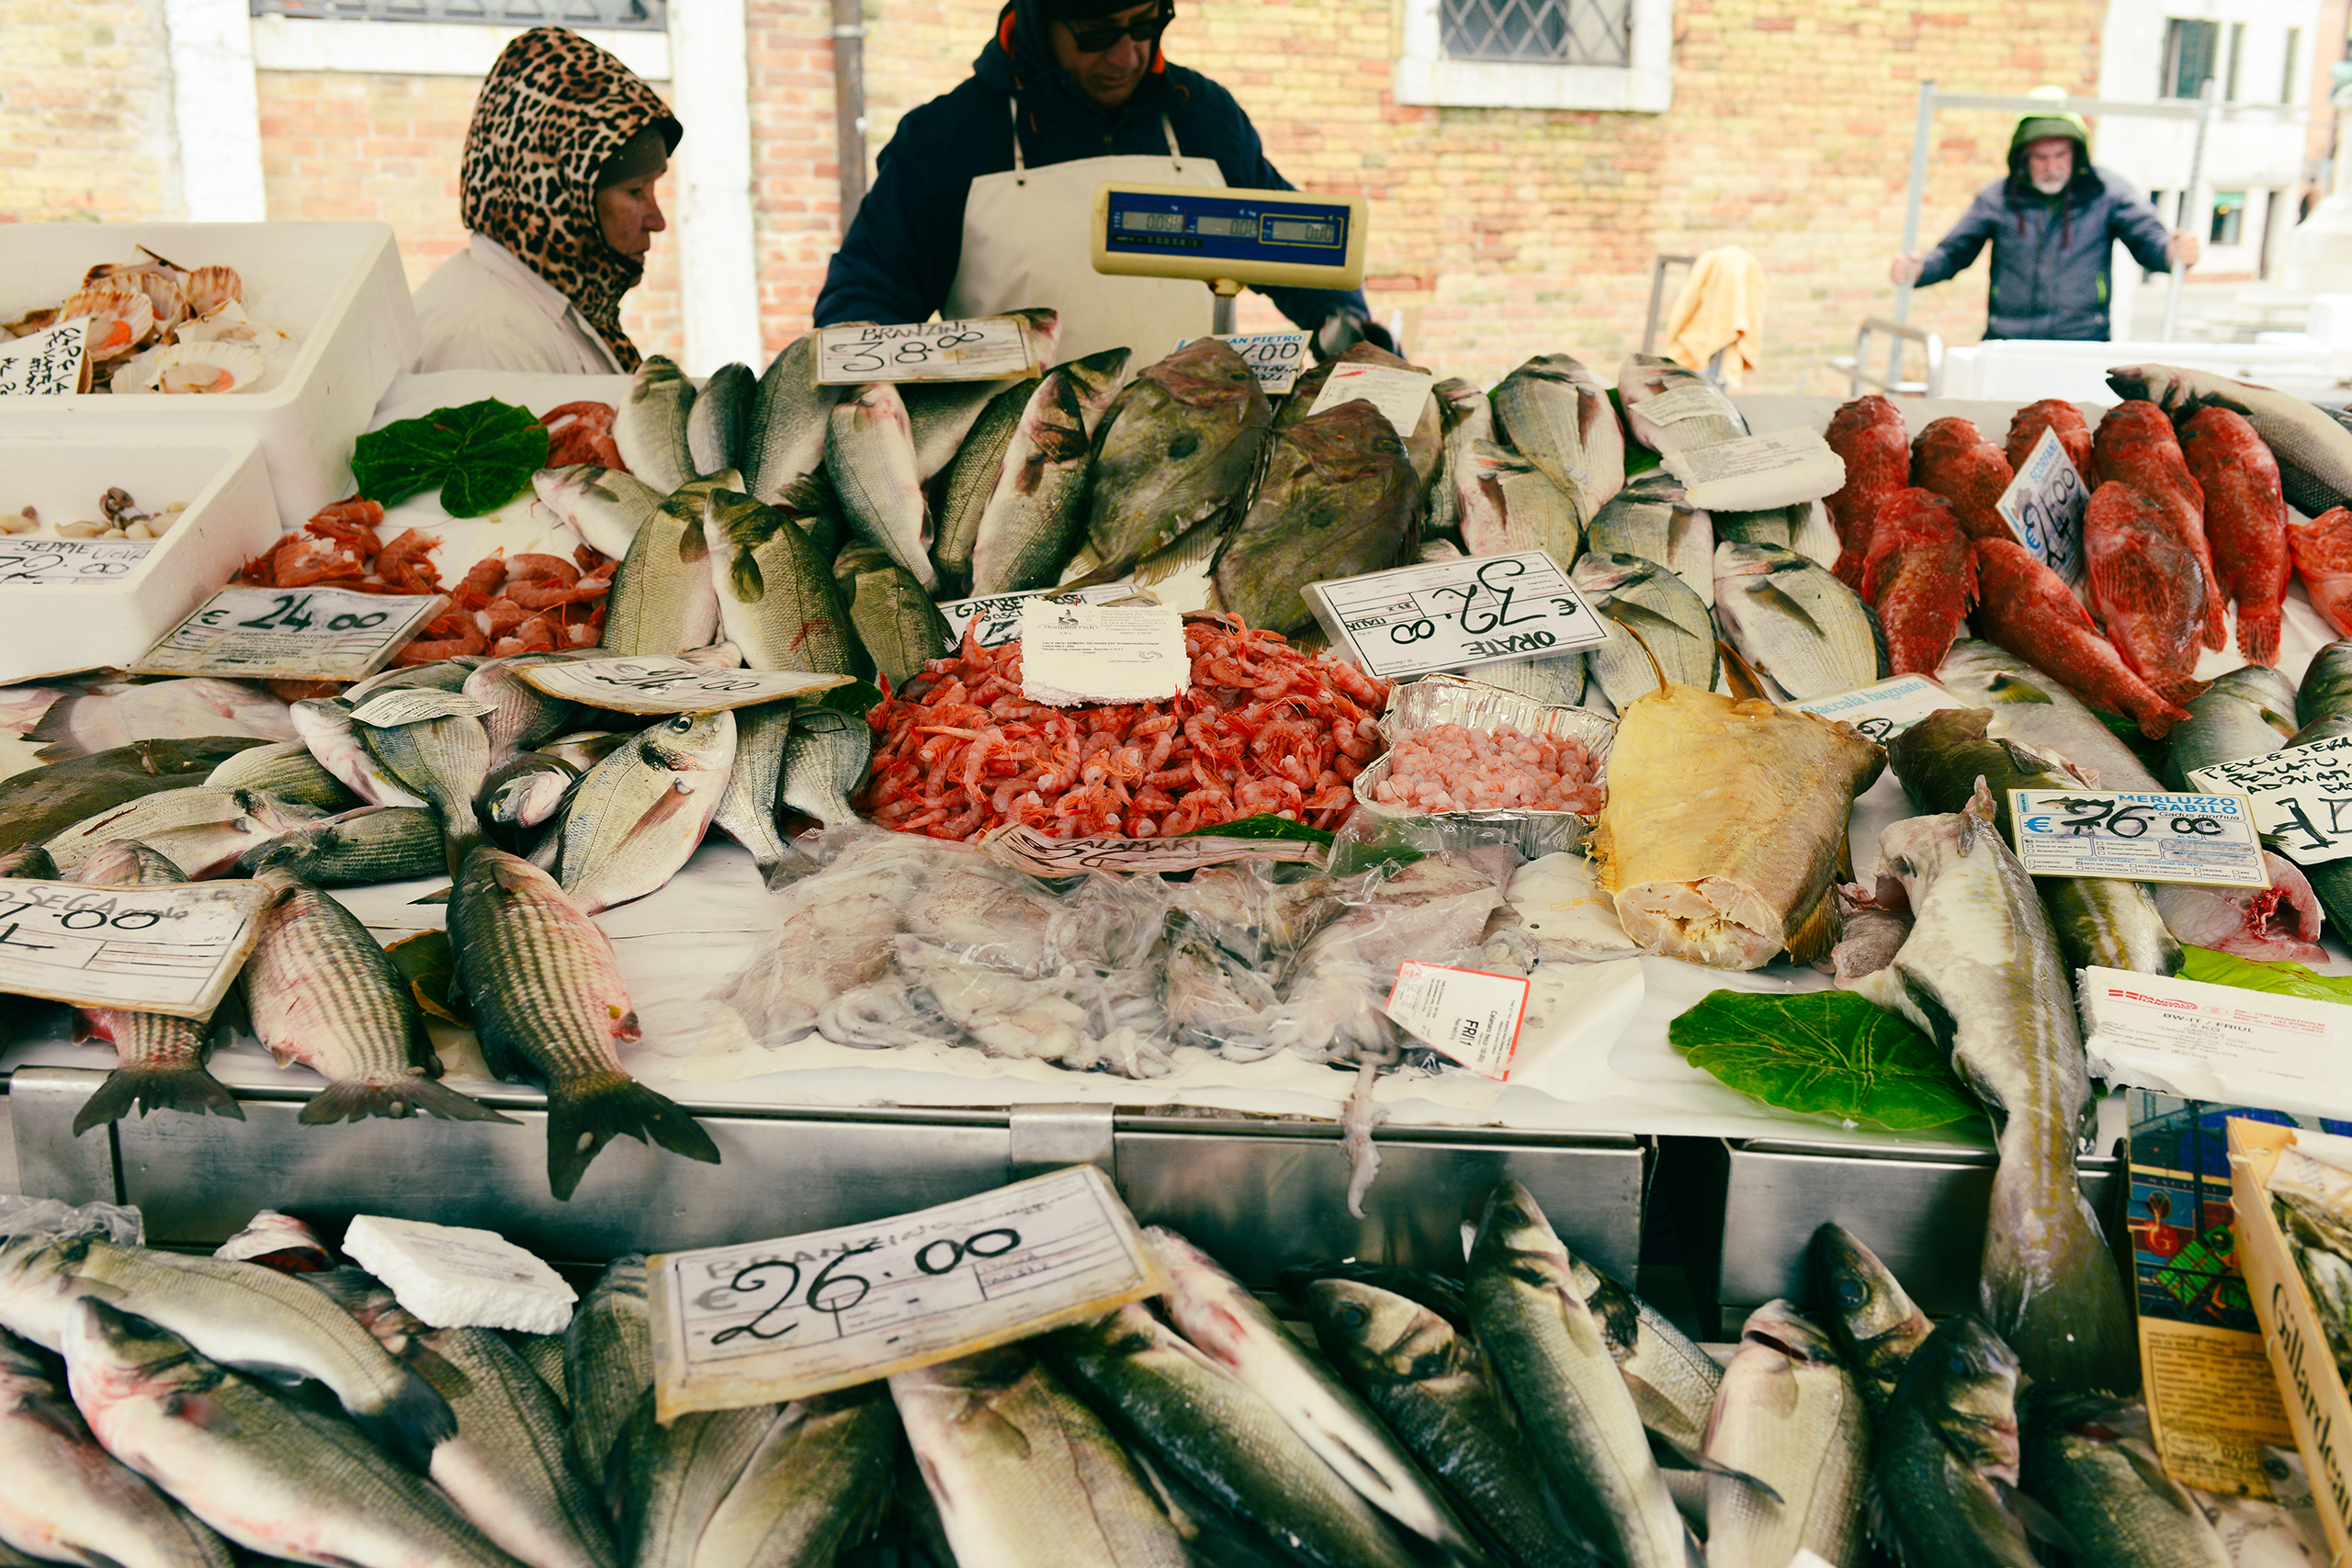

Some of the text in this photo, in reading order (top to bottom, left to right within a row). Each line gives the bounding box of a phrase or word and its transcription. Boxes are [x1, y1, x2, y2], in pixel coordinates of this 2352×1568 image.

[860, 321, 967, 342] BRANZINI
[1252, 335, 1303, 344] PIETRO
[2030, 438, 2059, 484] SCORFANI
[14, 540, 94, 554] SEPPIE
[2025, 527, 2041, 550] €
[1390, 558, 1578, 645] € 32.00
[200, 609, 231, 626] €
[238, 593, 389, 634] 24.00
[1460, 630, 1556, 657] ORATE
[1800, 681, 1929, 715] Baccalà bagnato
[2118, 794, 2236, 807] MERLUZZO
[2153, 803, 2239, 816] GABILO
[2024, 816, 2053, 834] €
[2158, 811, 2240, 821] Gadus morhua
[2163, 1013, 2202, 1023] BW-IT
[2216, 1022, 2256, 1034] FRIUL
[707, 1220, 956, 1280] BRANZINO
[710, 1227, 1022, 1346] 26.00
[691, 1286, 739, 1311] €
